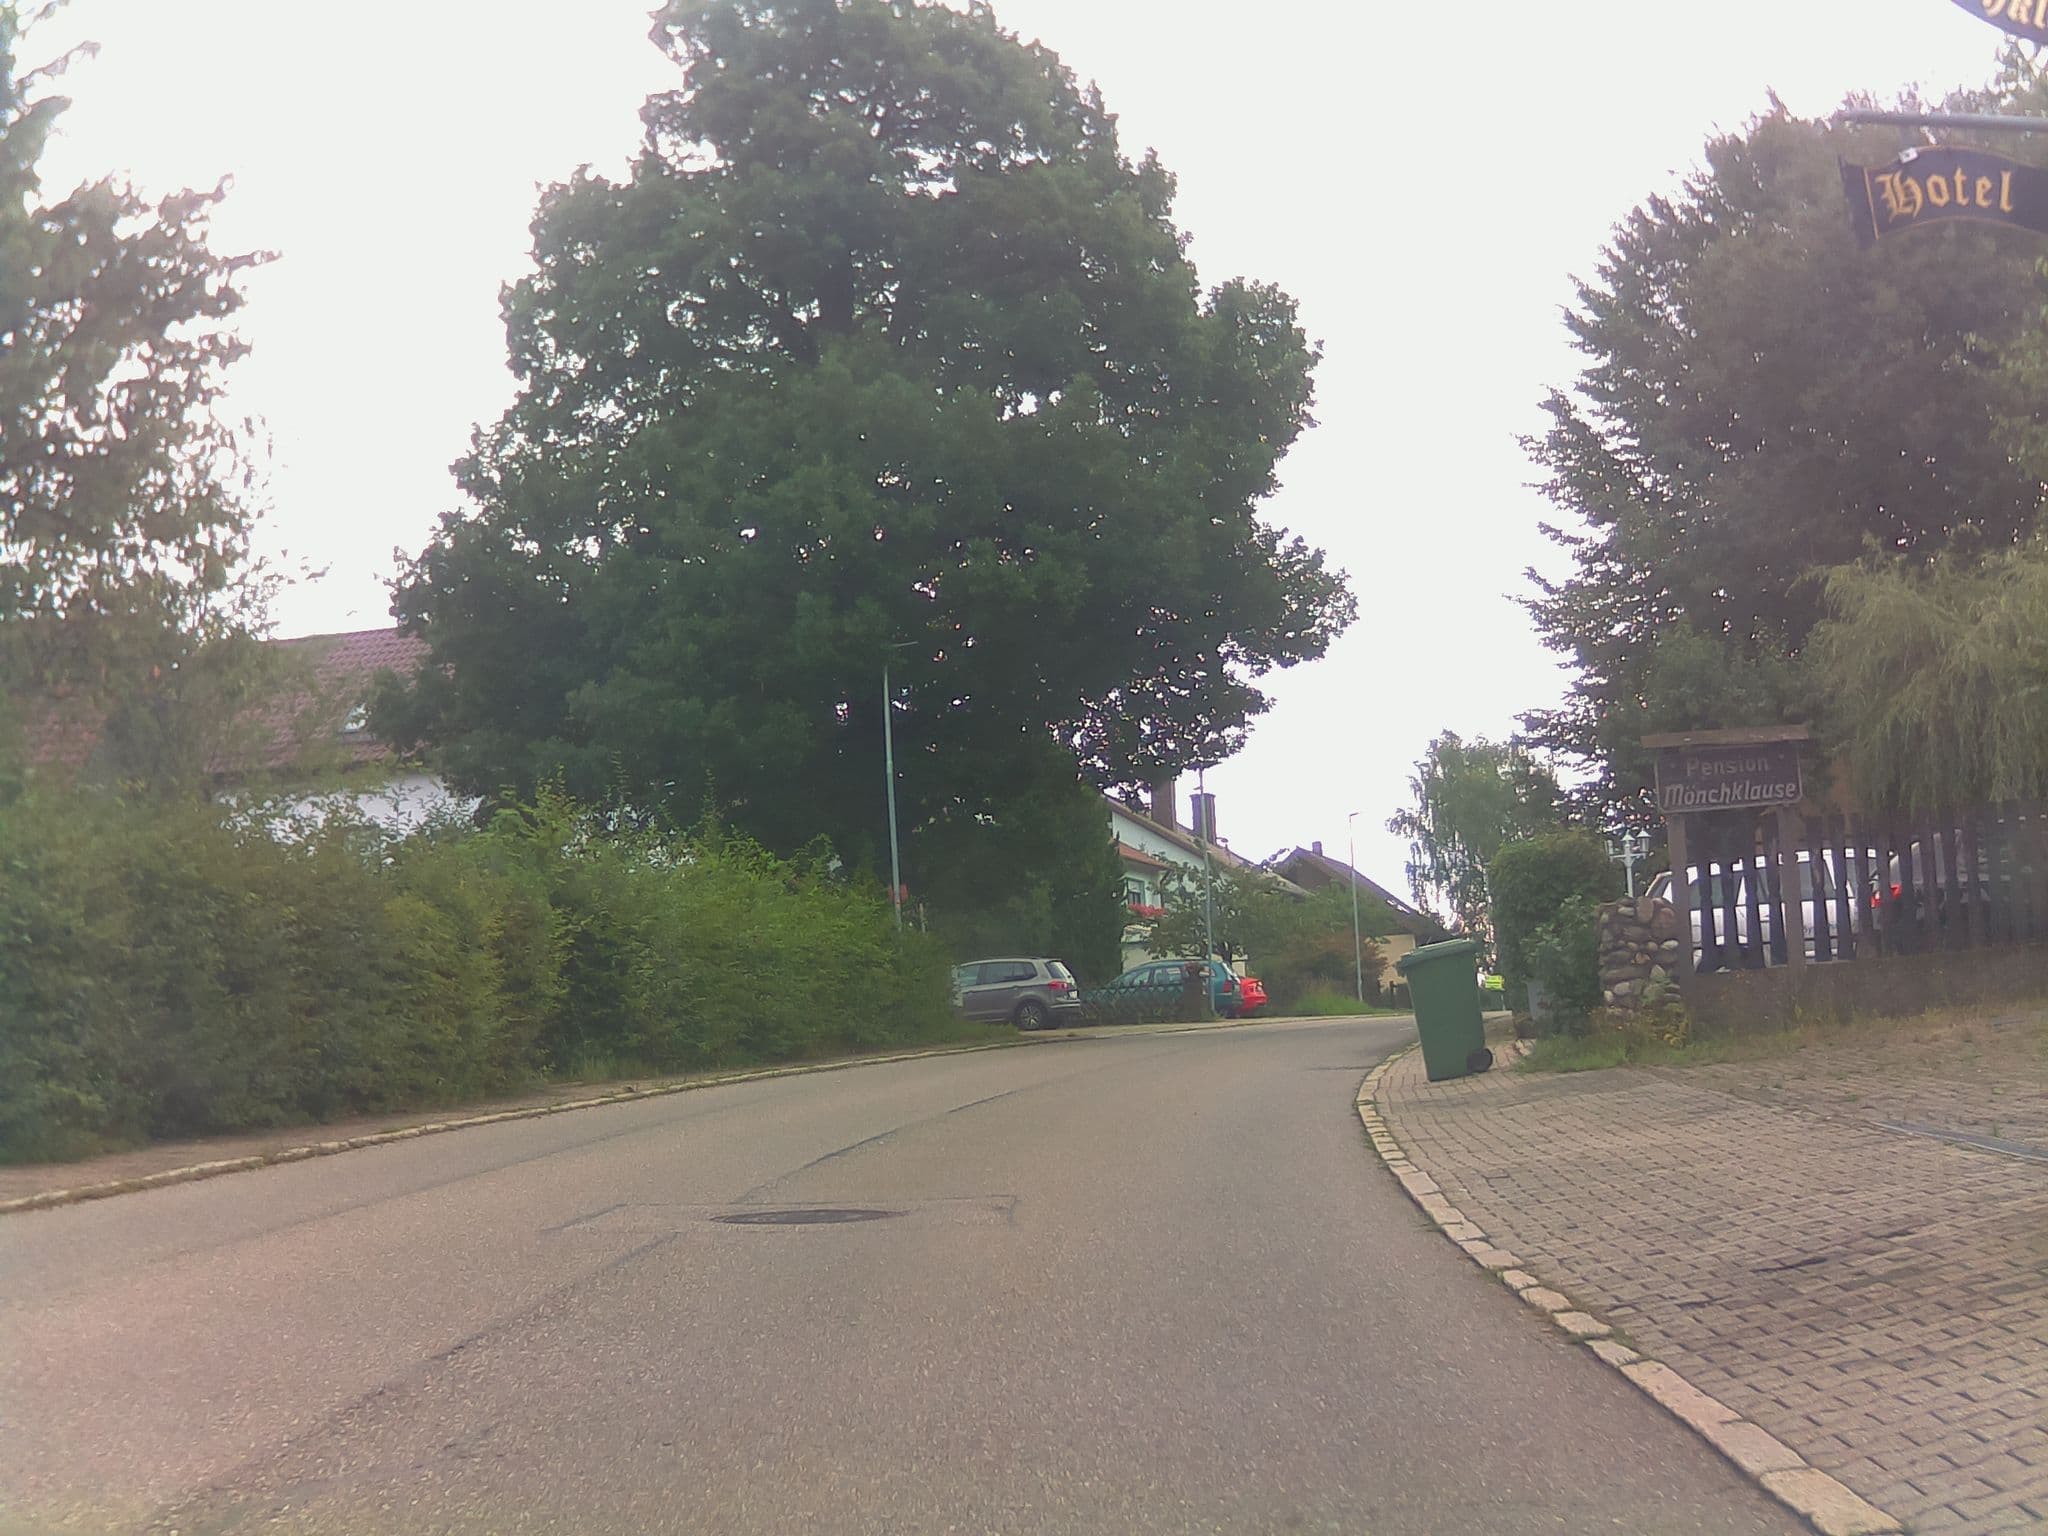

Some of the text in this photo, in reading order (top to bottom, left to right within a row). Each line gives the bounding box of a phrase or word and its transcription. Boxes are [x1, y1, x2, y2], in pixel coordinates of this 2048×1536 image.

[1875, 165, 2013, 223] Hotel
[1686, 756, 1770, 777] Pension
[1663, 780, 1796, 807] Mönchklause
